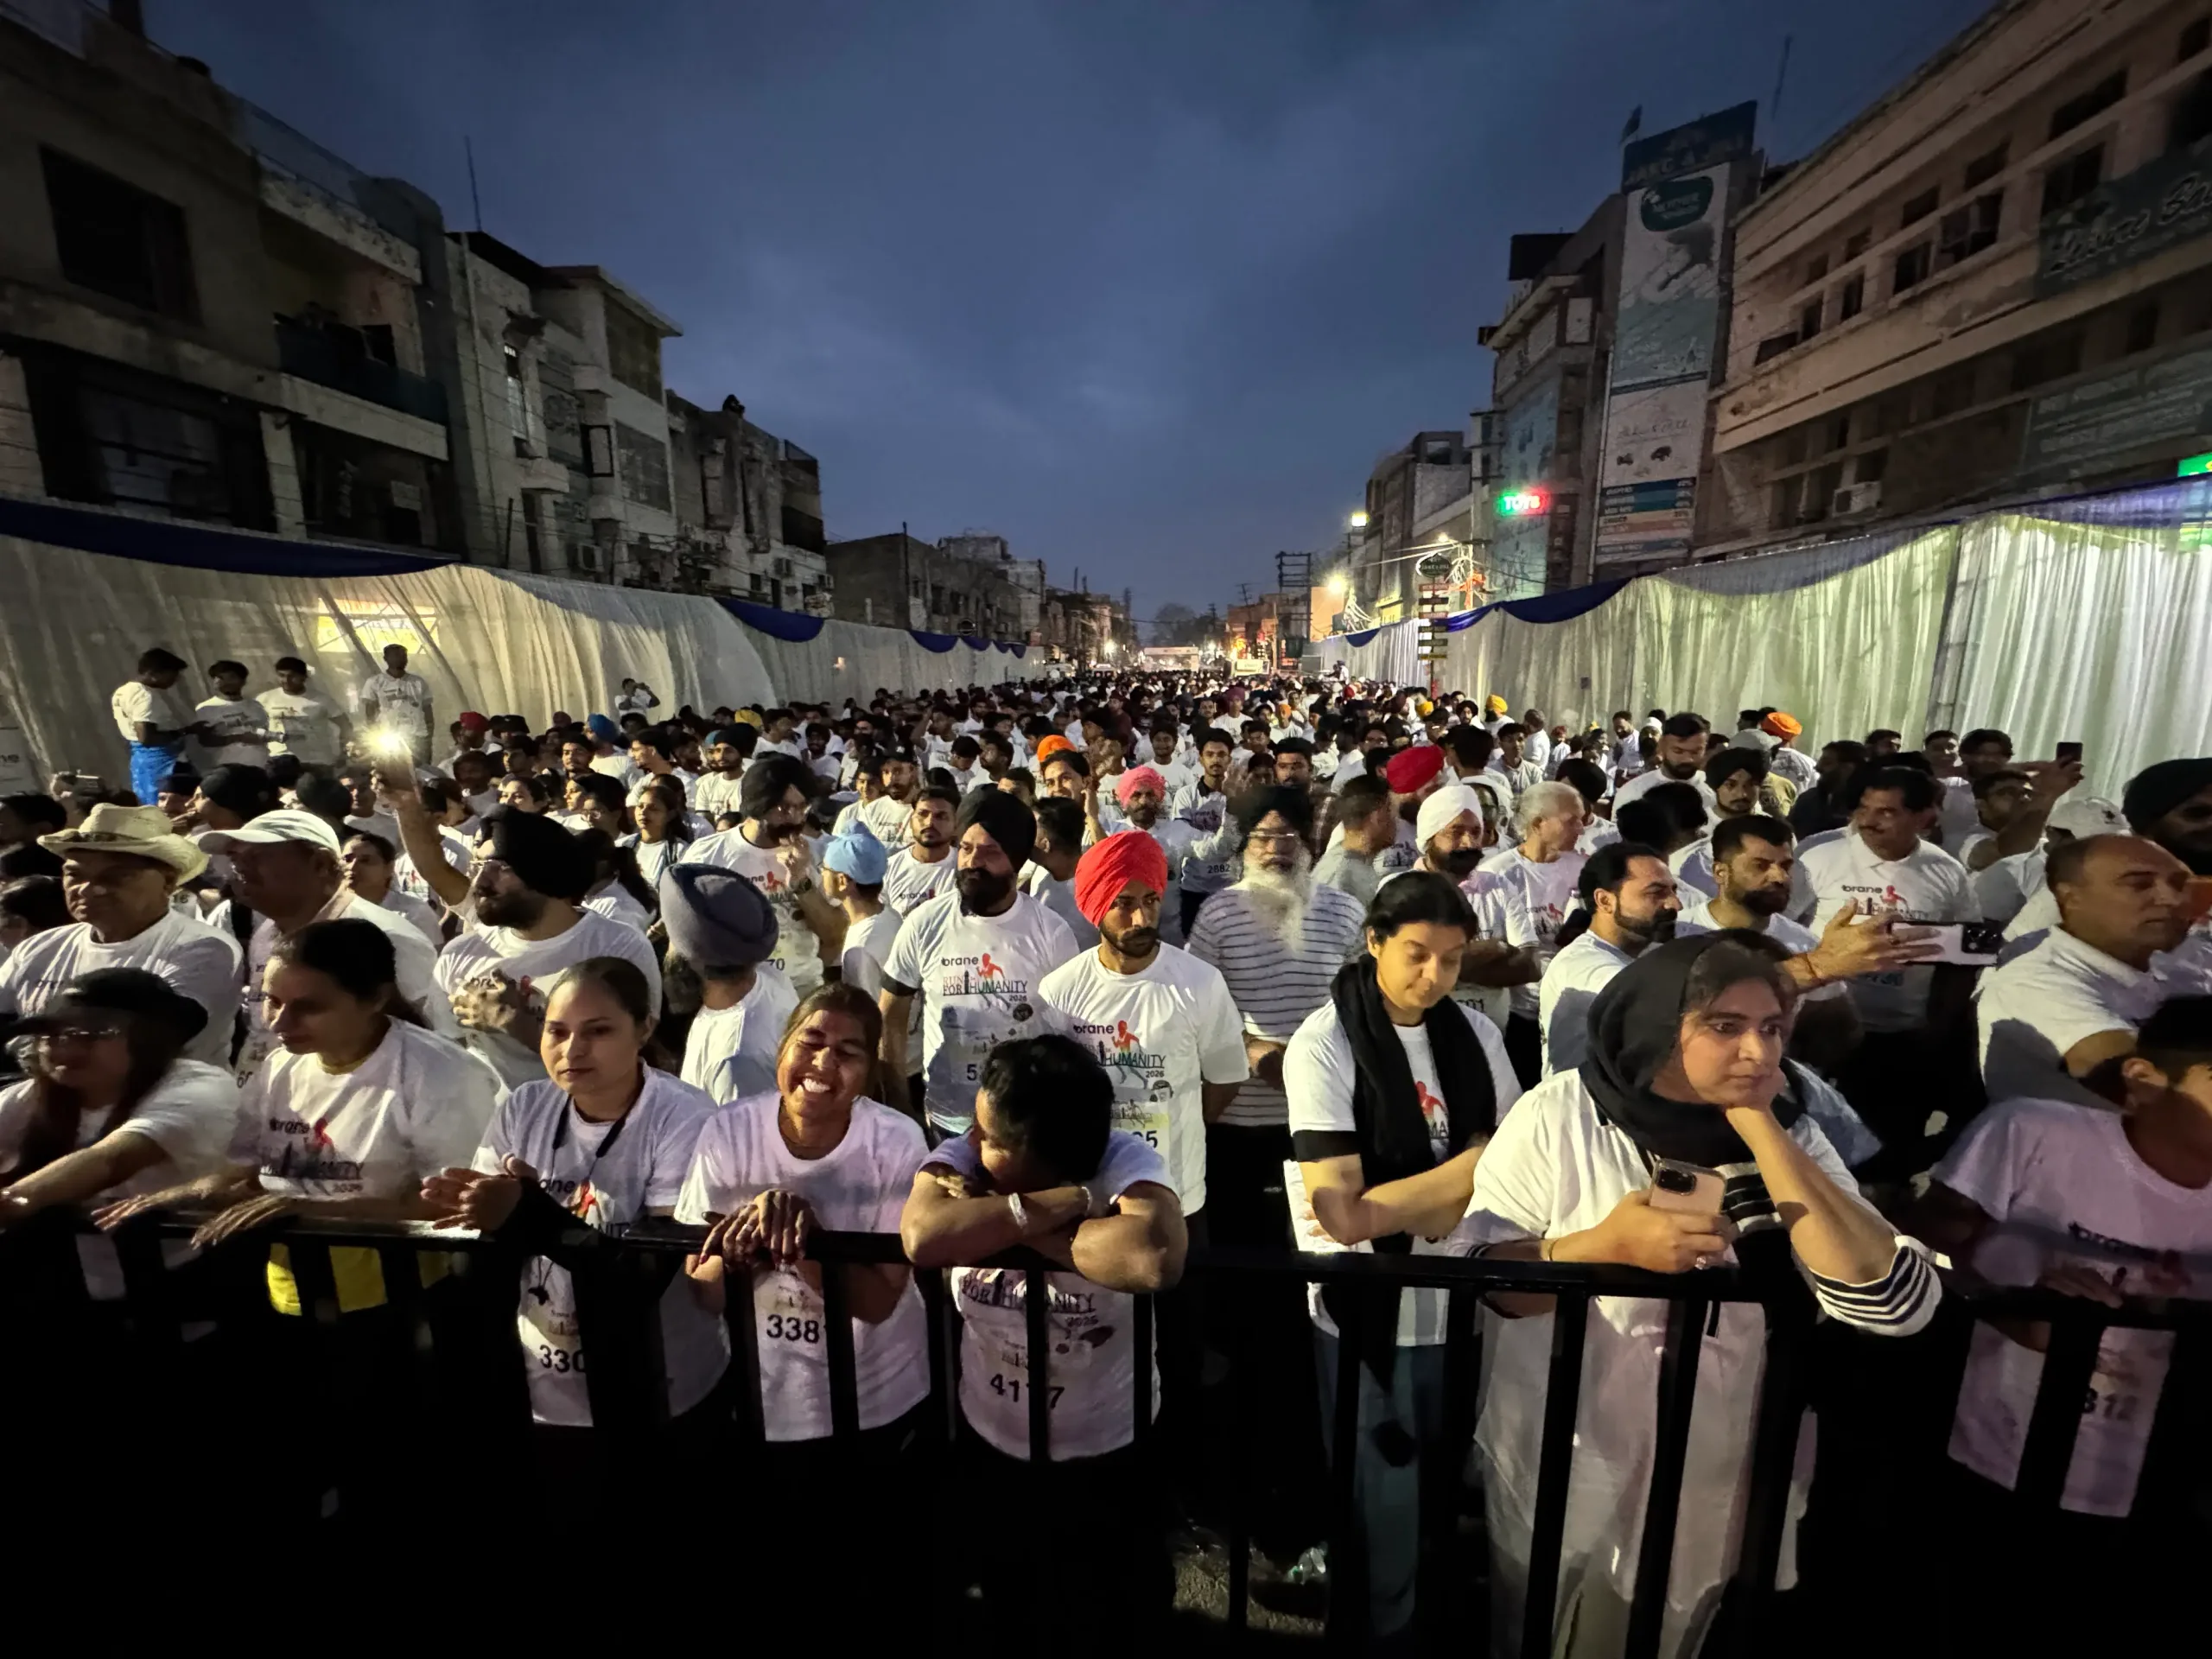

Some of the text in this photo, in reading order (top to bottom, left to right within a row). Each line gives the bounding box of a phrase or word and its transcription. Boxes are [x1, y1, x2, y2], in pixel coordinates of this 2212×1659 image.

[1503, 494, 1541, 511] TOYS
[1207, 864, 1231, 874] 2882
[1841, 884, 1883, 893] brane
[941, 956, 979, 967] brane
[943, 975, 963, 986] RUN
[943, 980, 1028, 995] FOR HUMANITY
[1073, 1024, 1115, 1034] brane
[1104, 1052, 1166, 1070] HUMANITY
[1145, 1070, 1165, 1078] 2026
[540, 1177, 575, 1194] ane
[989, 1374, 1065, 1409] 417
